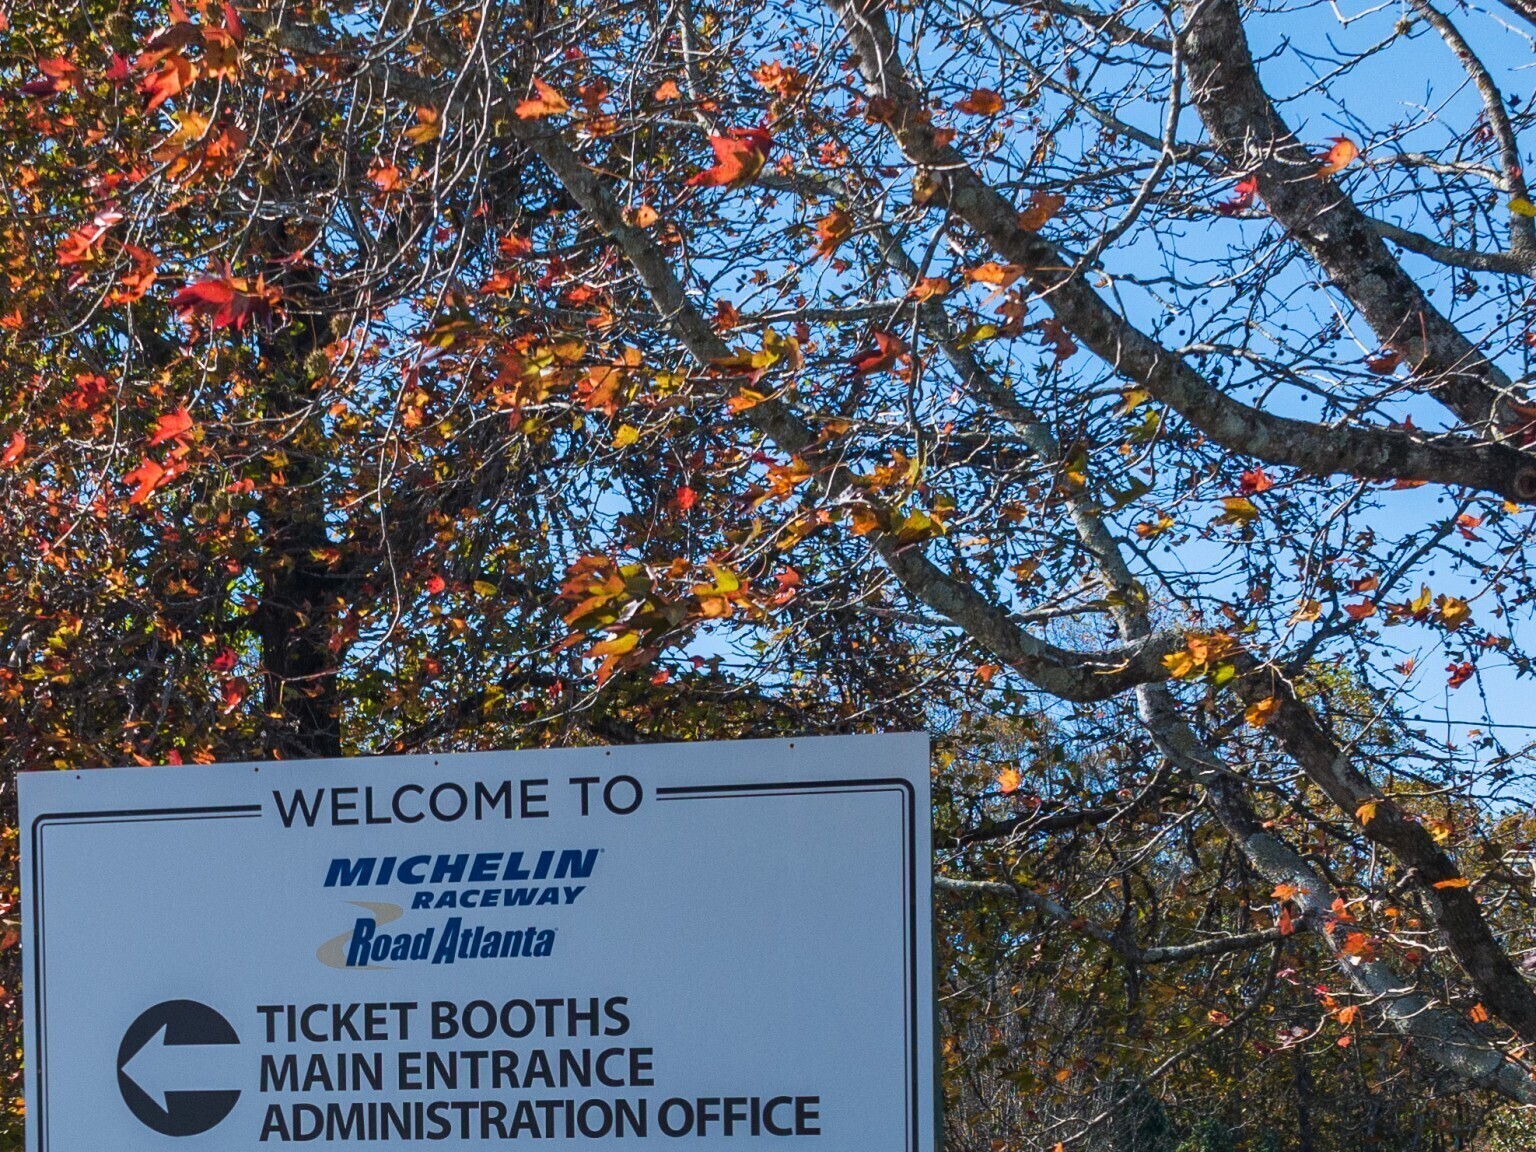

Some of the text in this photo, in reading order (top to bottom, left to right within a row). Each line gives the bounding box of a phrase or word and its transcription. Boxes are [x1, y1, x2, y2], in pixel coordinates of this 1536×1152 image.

[273, 775, 643, 828] WELCOME TO
[323, 848, 600, 887] MICHELIN
[410, 886, 586, 909] RACEWAY
[257, 997, 630, 1042] TICKET BOOTHS
[260, 1048, 654, 1092] MAIN ENTRANCE
[259, 1096, 820, 1141] ADMINISTRATION OFFICE
